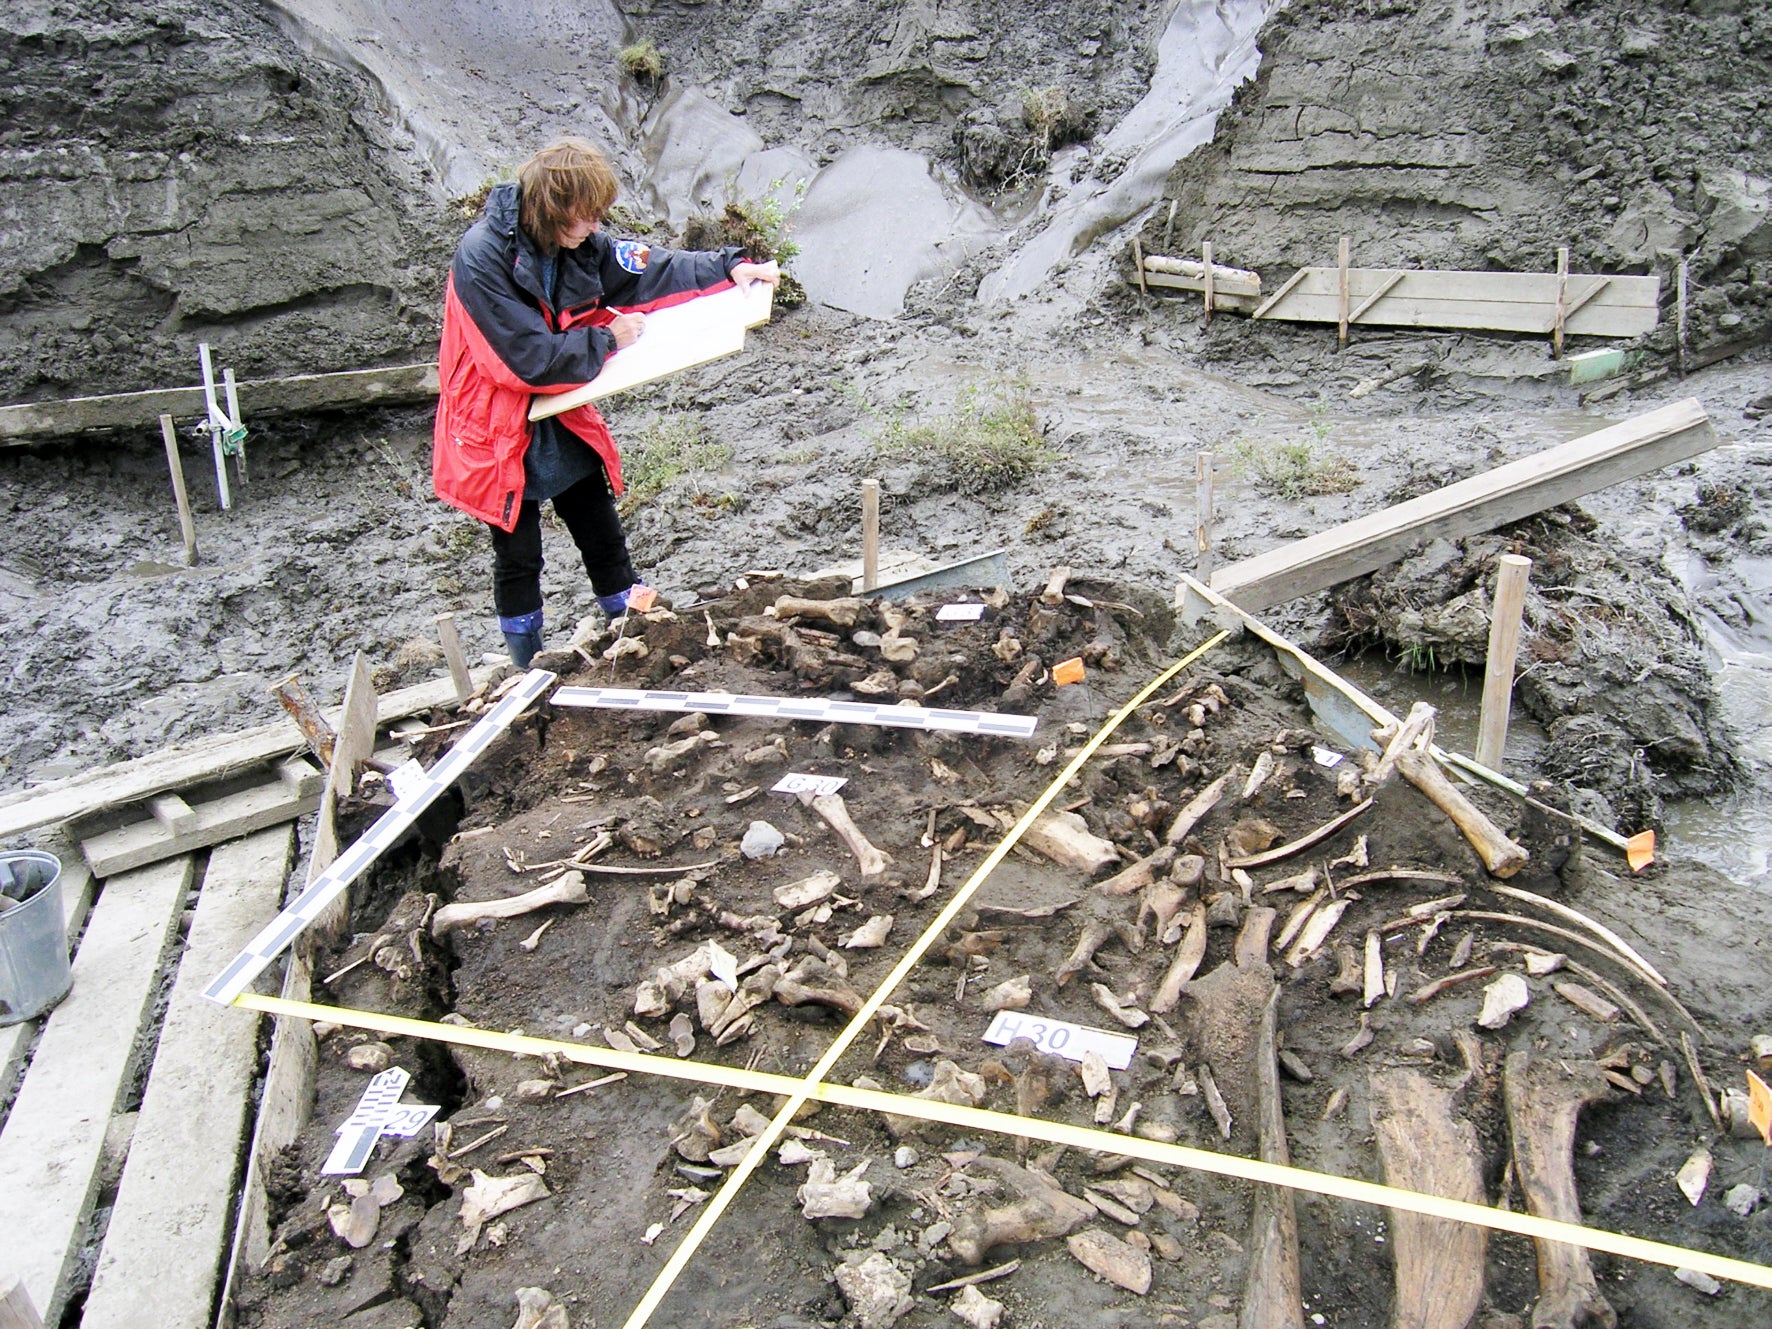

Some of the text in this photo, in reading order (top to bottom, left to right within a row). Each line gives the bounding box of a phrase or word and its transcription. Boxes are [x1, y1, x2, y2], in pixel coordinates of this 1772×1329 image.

[994, 1017, 1070, 1050] H 30
[383, 1109, 428, 1131] 29
